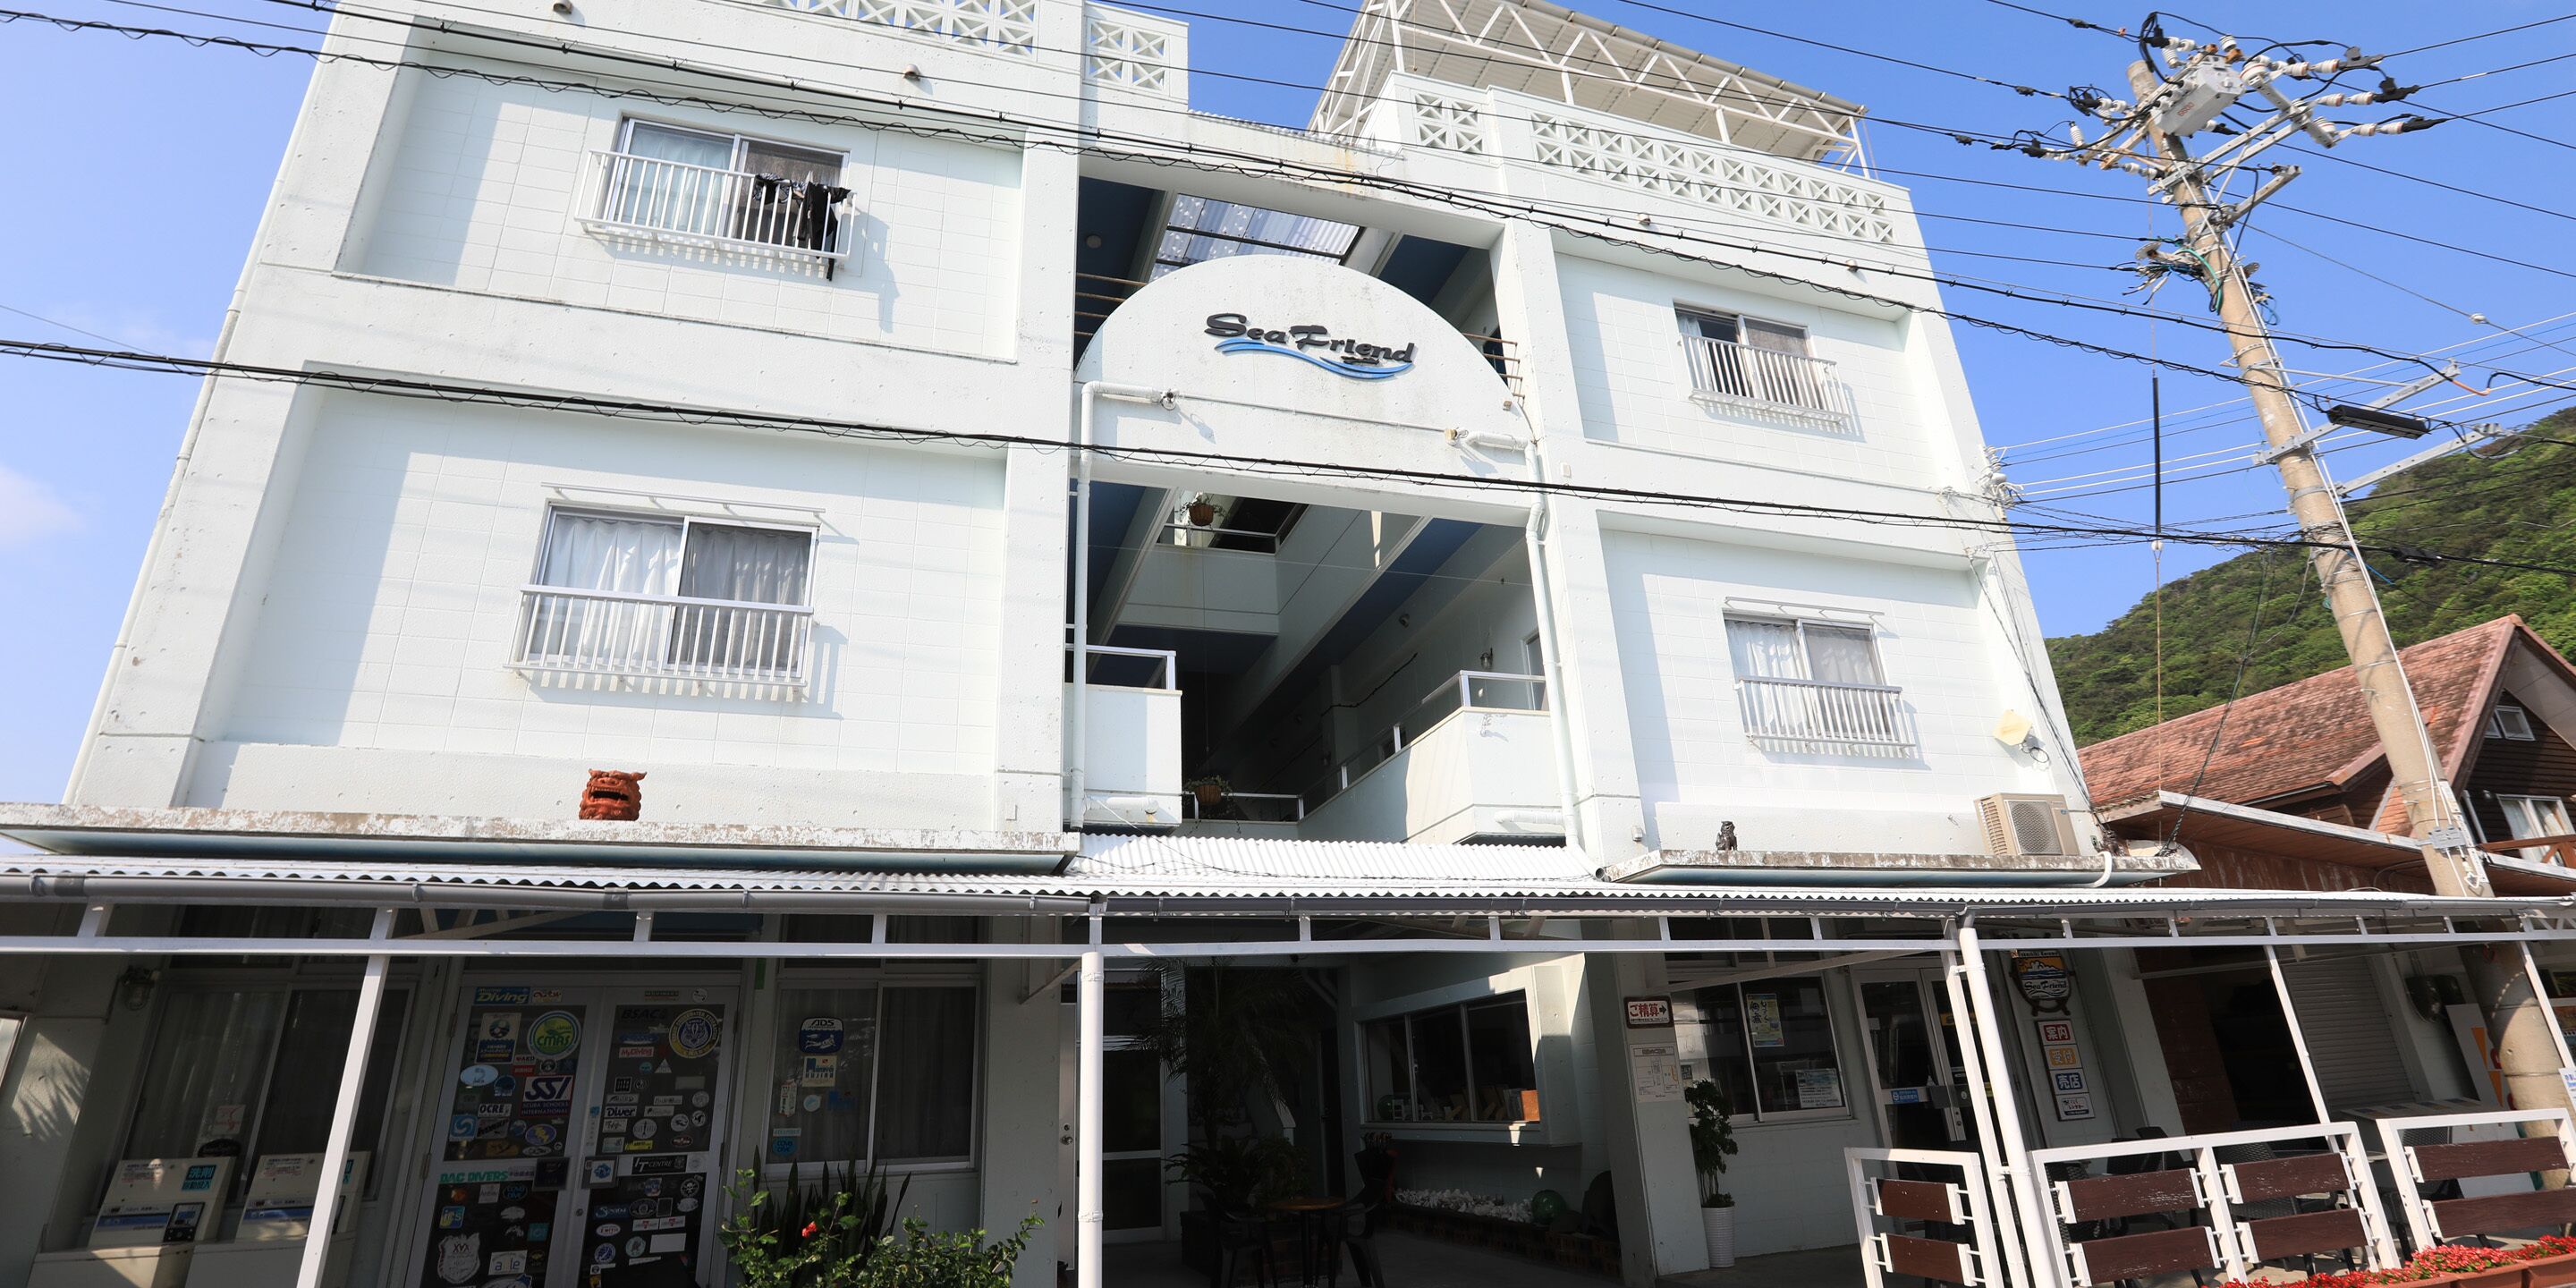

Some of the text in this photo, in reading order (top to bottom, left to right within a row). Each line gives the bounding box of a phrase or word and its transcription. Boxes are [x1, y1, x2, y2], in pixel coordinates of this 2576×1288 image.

[1204, 313, 1415, 363] Sea Friend
[2025, 980, 2066, 990] Sea Friend
[477, 992, 528, 1004] Diving
[1630, 1004, 1659, 1018] ご精算
[2046, 1025, 2069, 1040] 案内
[2052, 1049, 2074, 1063] 受付
[2058, 1073, 2081, 1089] 売店
[526, 1077, 572, 1100] SSI
[606, 1107, 636, 1116] Diver
[467, 1170, 508, 1182] DIVERS
